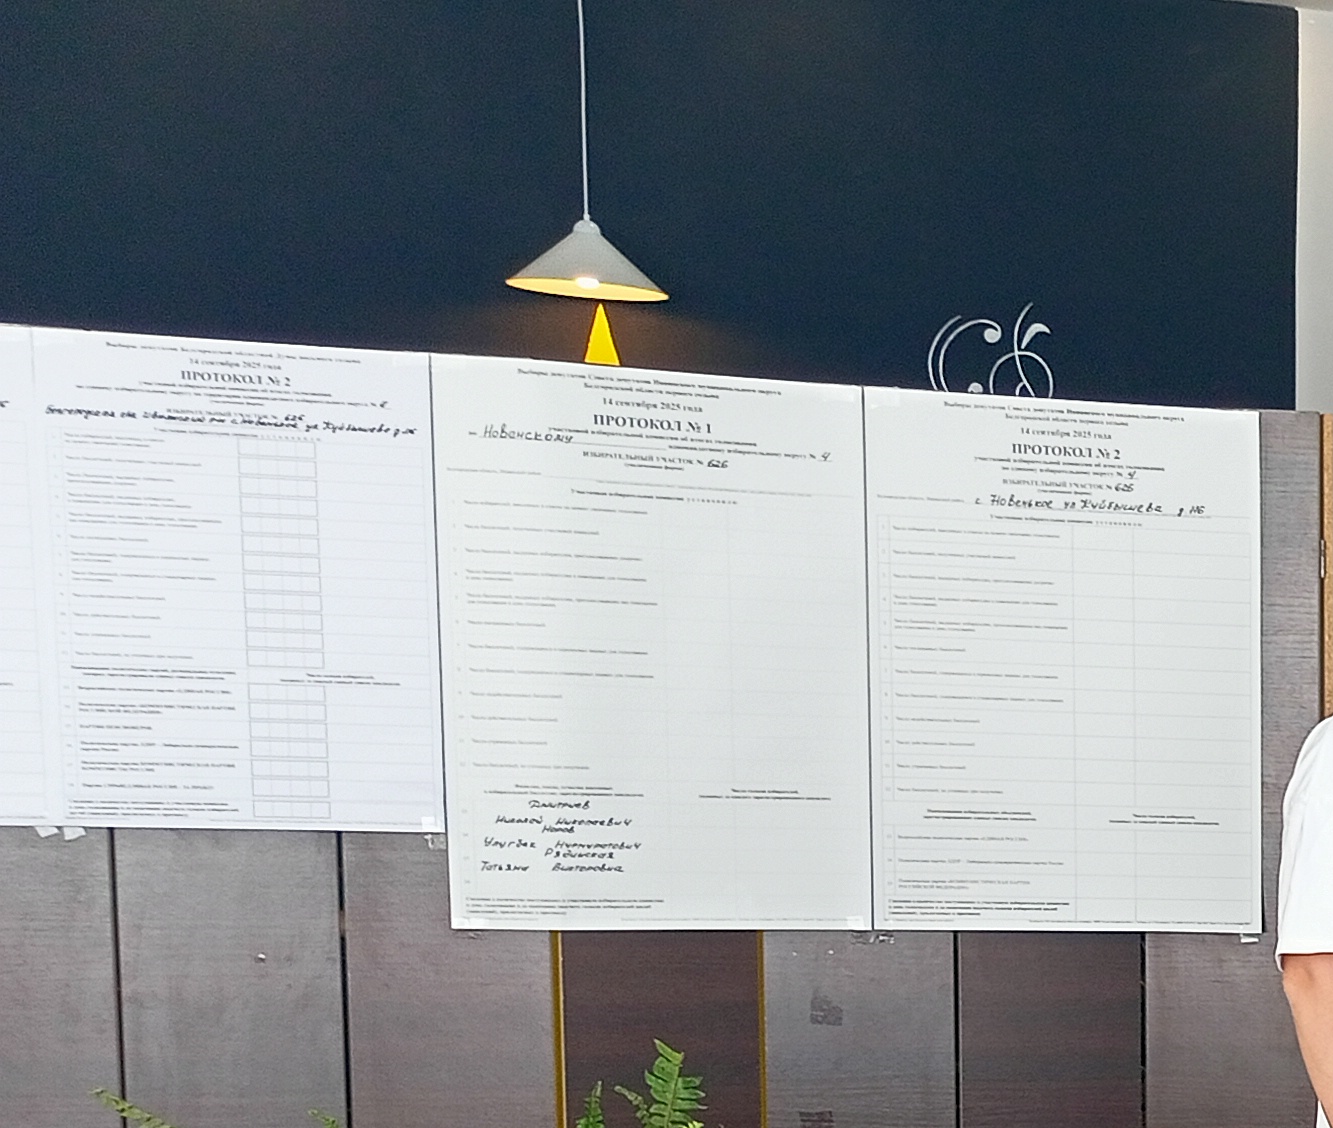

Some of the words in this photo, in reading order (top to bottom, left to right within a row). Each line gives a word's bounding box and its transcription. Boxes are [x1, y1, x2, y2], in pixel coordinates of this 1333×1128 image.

[181, 370, 262, 385] ПРОТОКОЛ
[593, 413, 682, 432] ПРОТОКОЛ
[686, 421, 702, 434] №
[706, 423, 711, 434] 1
[1012, 443, 1092, 458] ПРОТОКОЛ
[1096, 448, 1110, 459] №
[1113, 449, 1121, 460] 2
